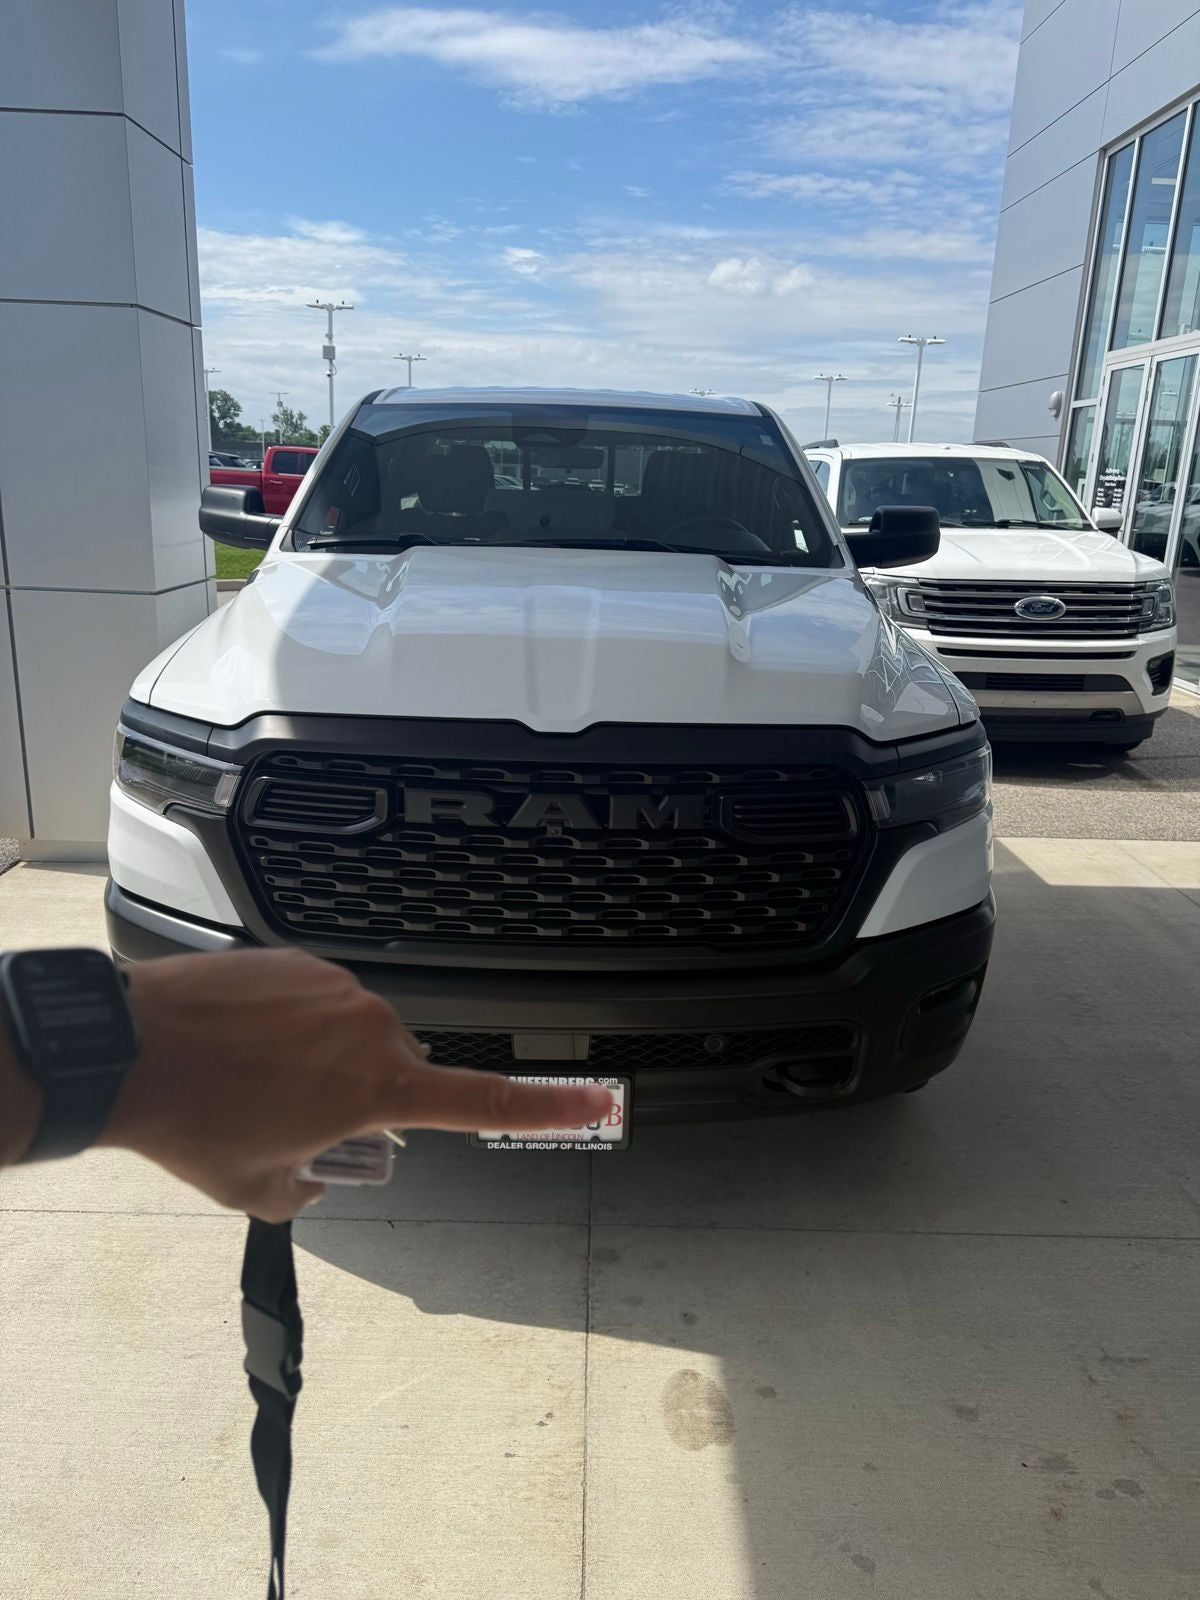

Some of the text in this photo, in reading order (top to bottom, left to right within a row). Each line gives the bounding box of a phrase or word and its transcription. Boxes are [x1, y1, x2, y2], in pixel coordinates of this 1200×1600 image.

[1029, 601, 1055, 613] Ford
[403, 784, 706, 830] RAM
[487, 1142, 613, 1151] DEALER GROUP OF ILLINOIS
